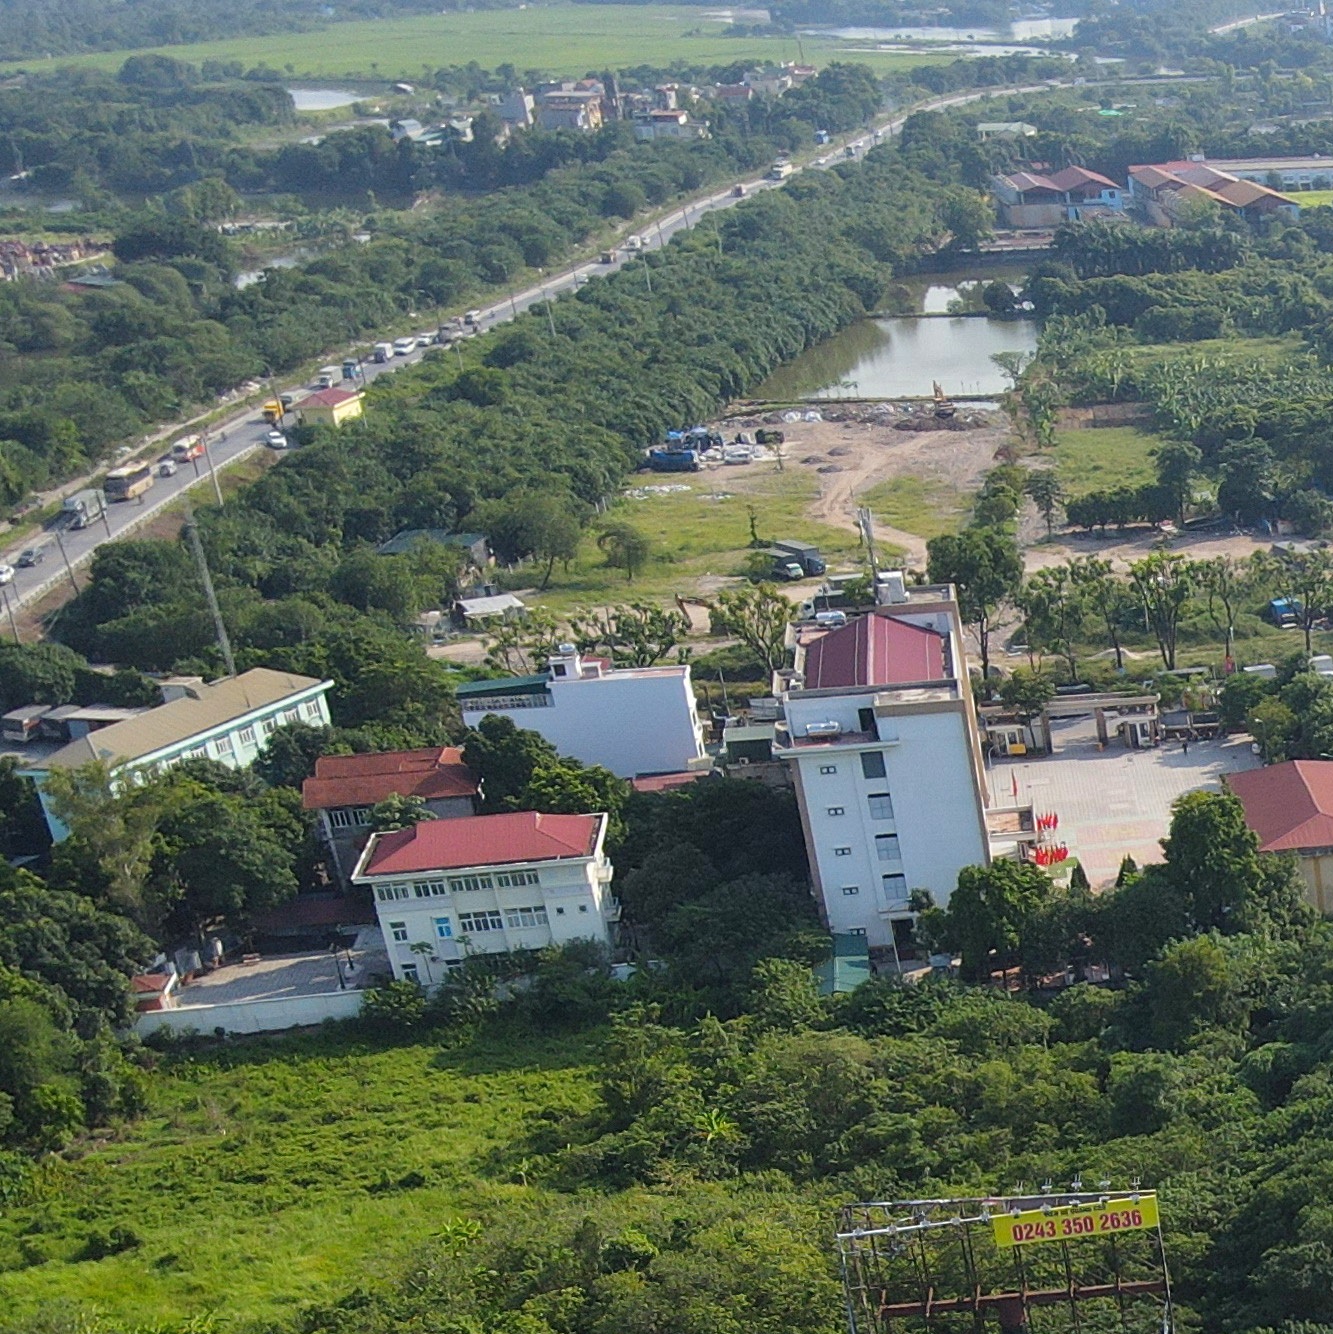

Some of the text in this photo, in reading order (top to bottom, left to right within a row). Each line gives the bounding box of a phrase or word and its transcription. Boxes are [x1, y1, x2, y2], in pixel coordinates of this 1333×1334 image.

[1012, 1220, 1057, 1242] 0243
[1061, 1215, 1095, 1236] 350
[1100, 1209, 1143, 1231] 2636
